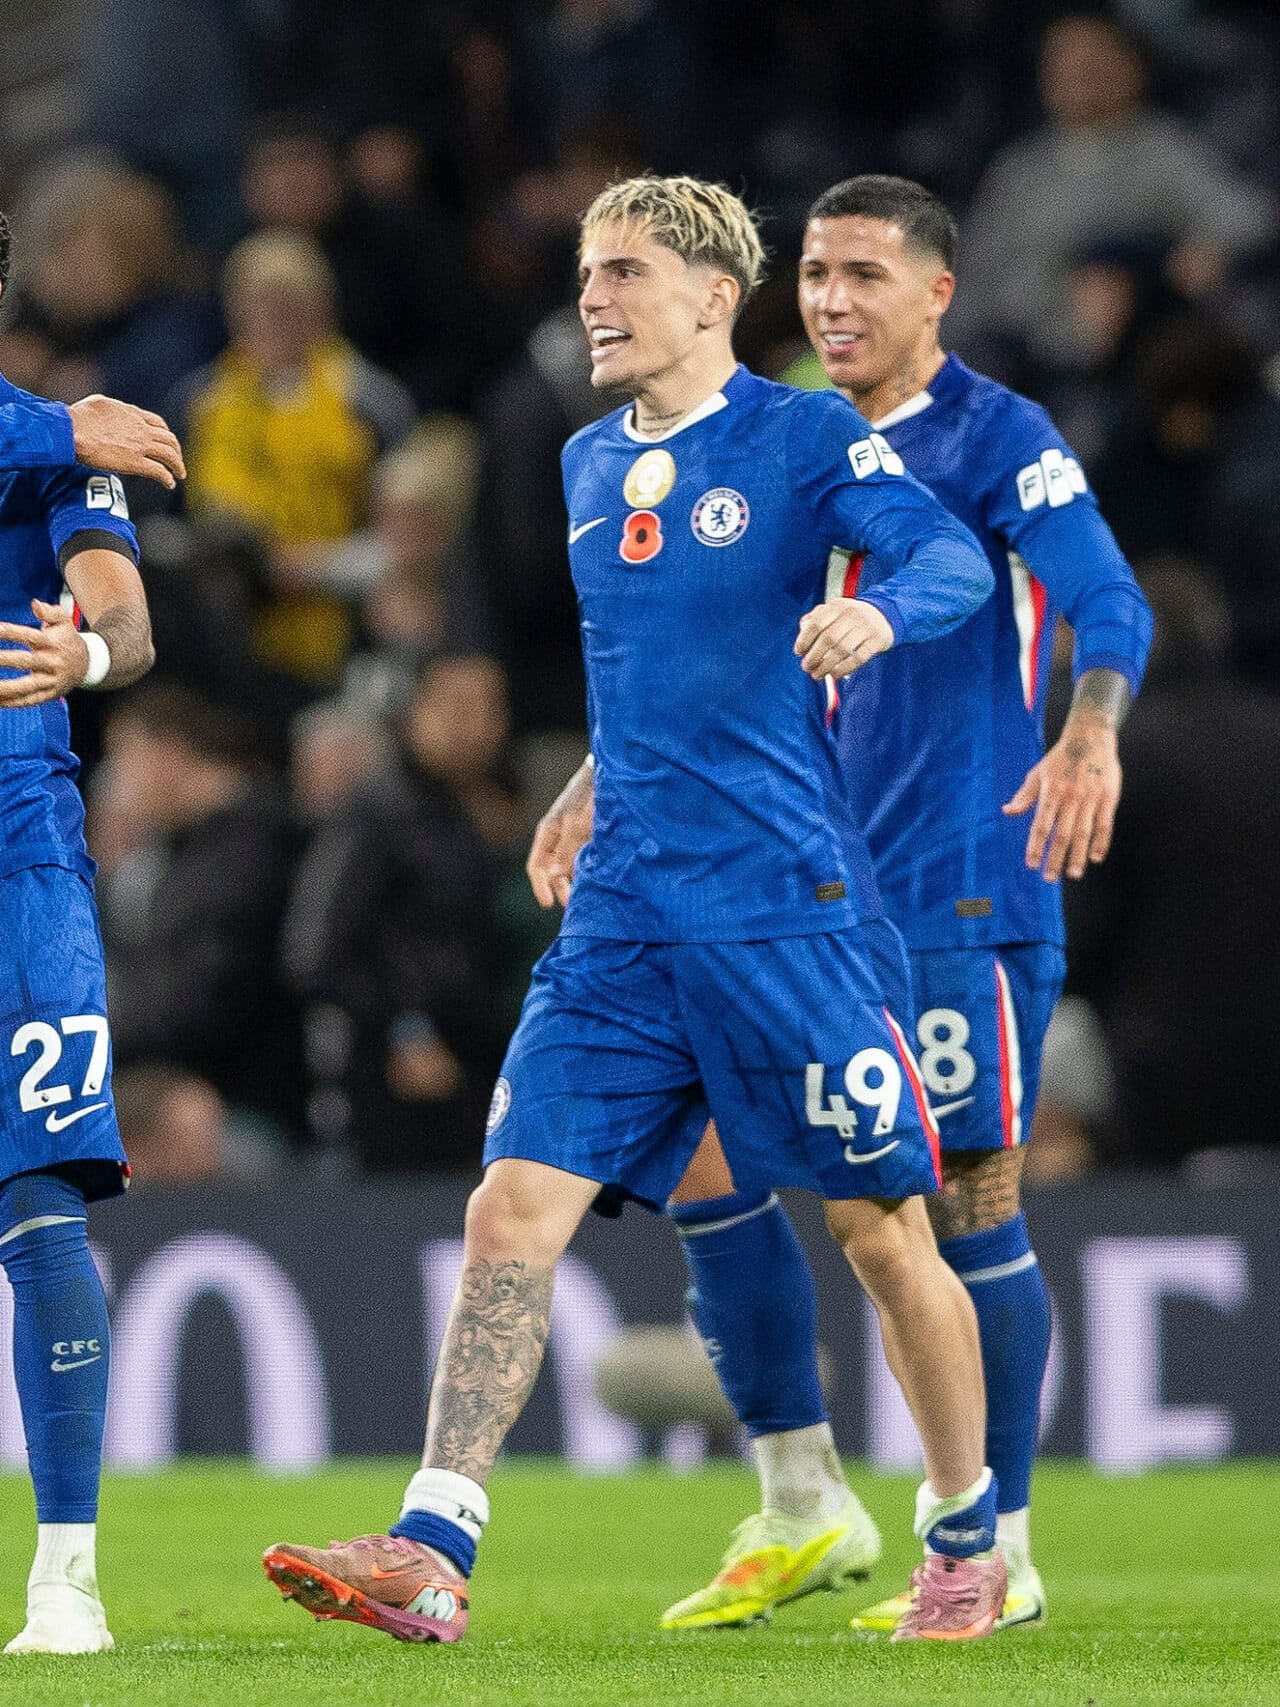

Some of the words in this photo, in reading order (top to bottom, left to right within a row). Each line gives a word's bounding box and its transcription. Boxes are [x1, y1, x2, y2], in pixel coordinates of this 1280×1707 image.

[11, 1014, 109, 1113] 27
[805, 1047, 902, 1139] 49
[916, 1007, 977, 1096] 8
[52, 1339, 101, 1355] CFC
